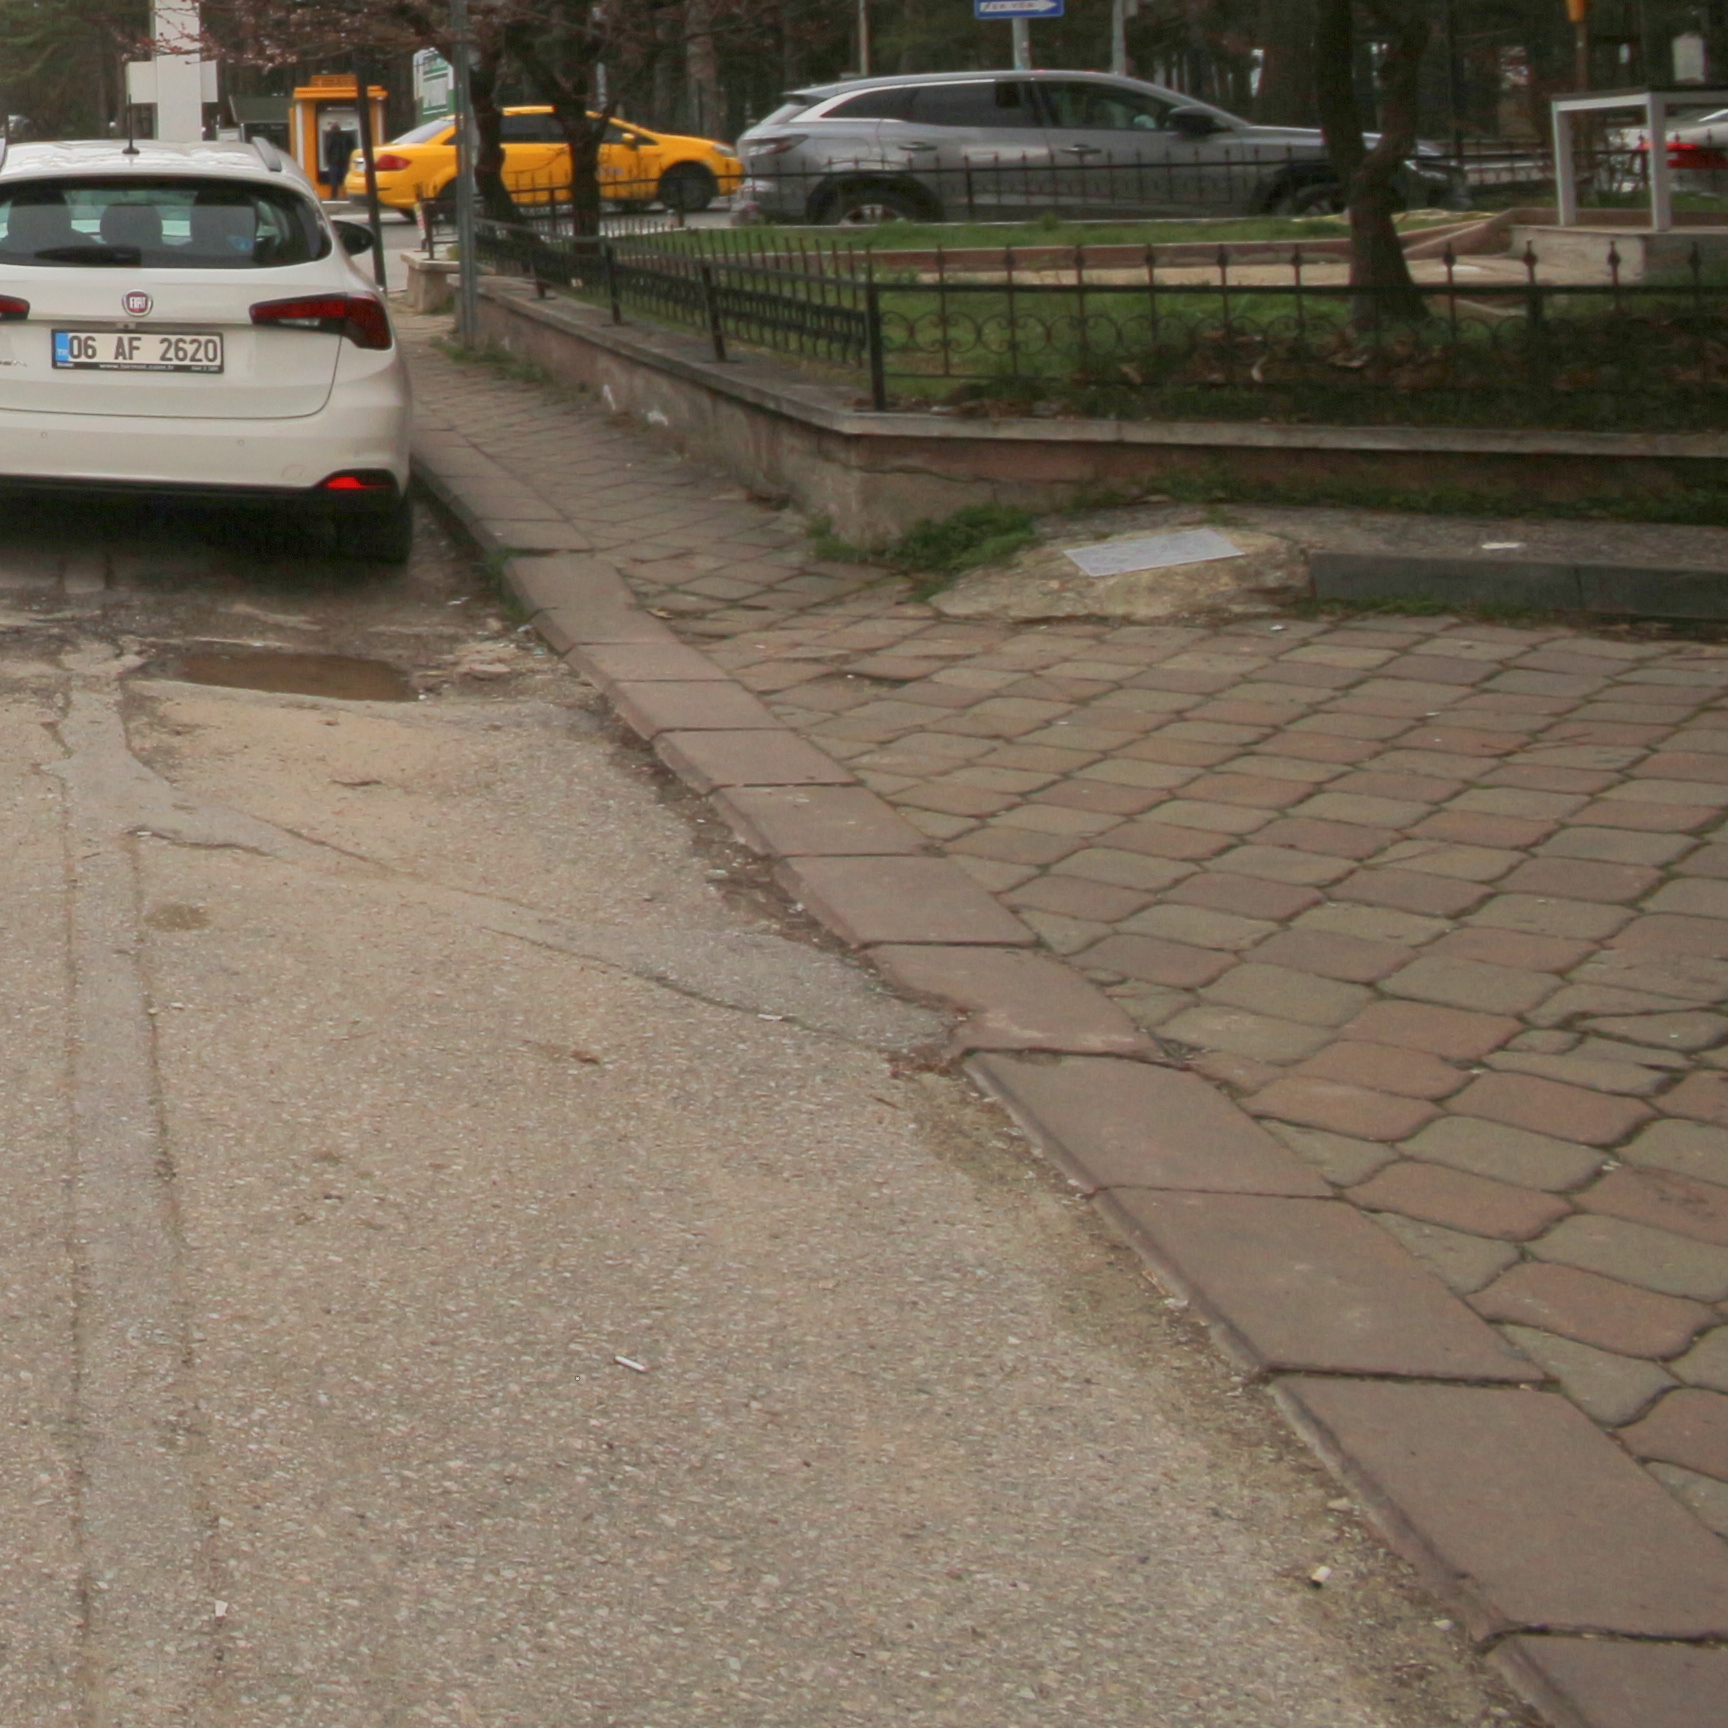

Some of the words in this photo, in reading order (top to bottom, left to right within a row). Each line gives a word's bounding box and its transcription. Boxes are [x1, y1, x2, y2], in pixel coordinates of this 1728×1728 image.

[129, 296, 147, 310] FIAT
[69, 335, 97, 360] 06
[114, 336, 142, 361] AF
[159, 337, 218, 363] 2620
